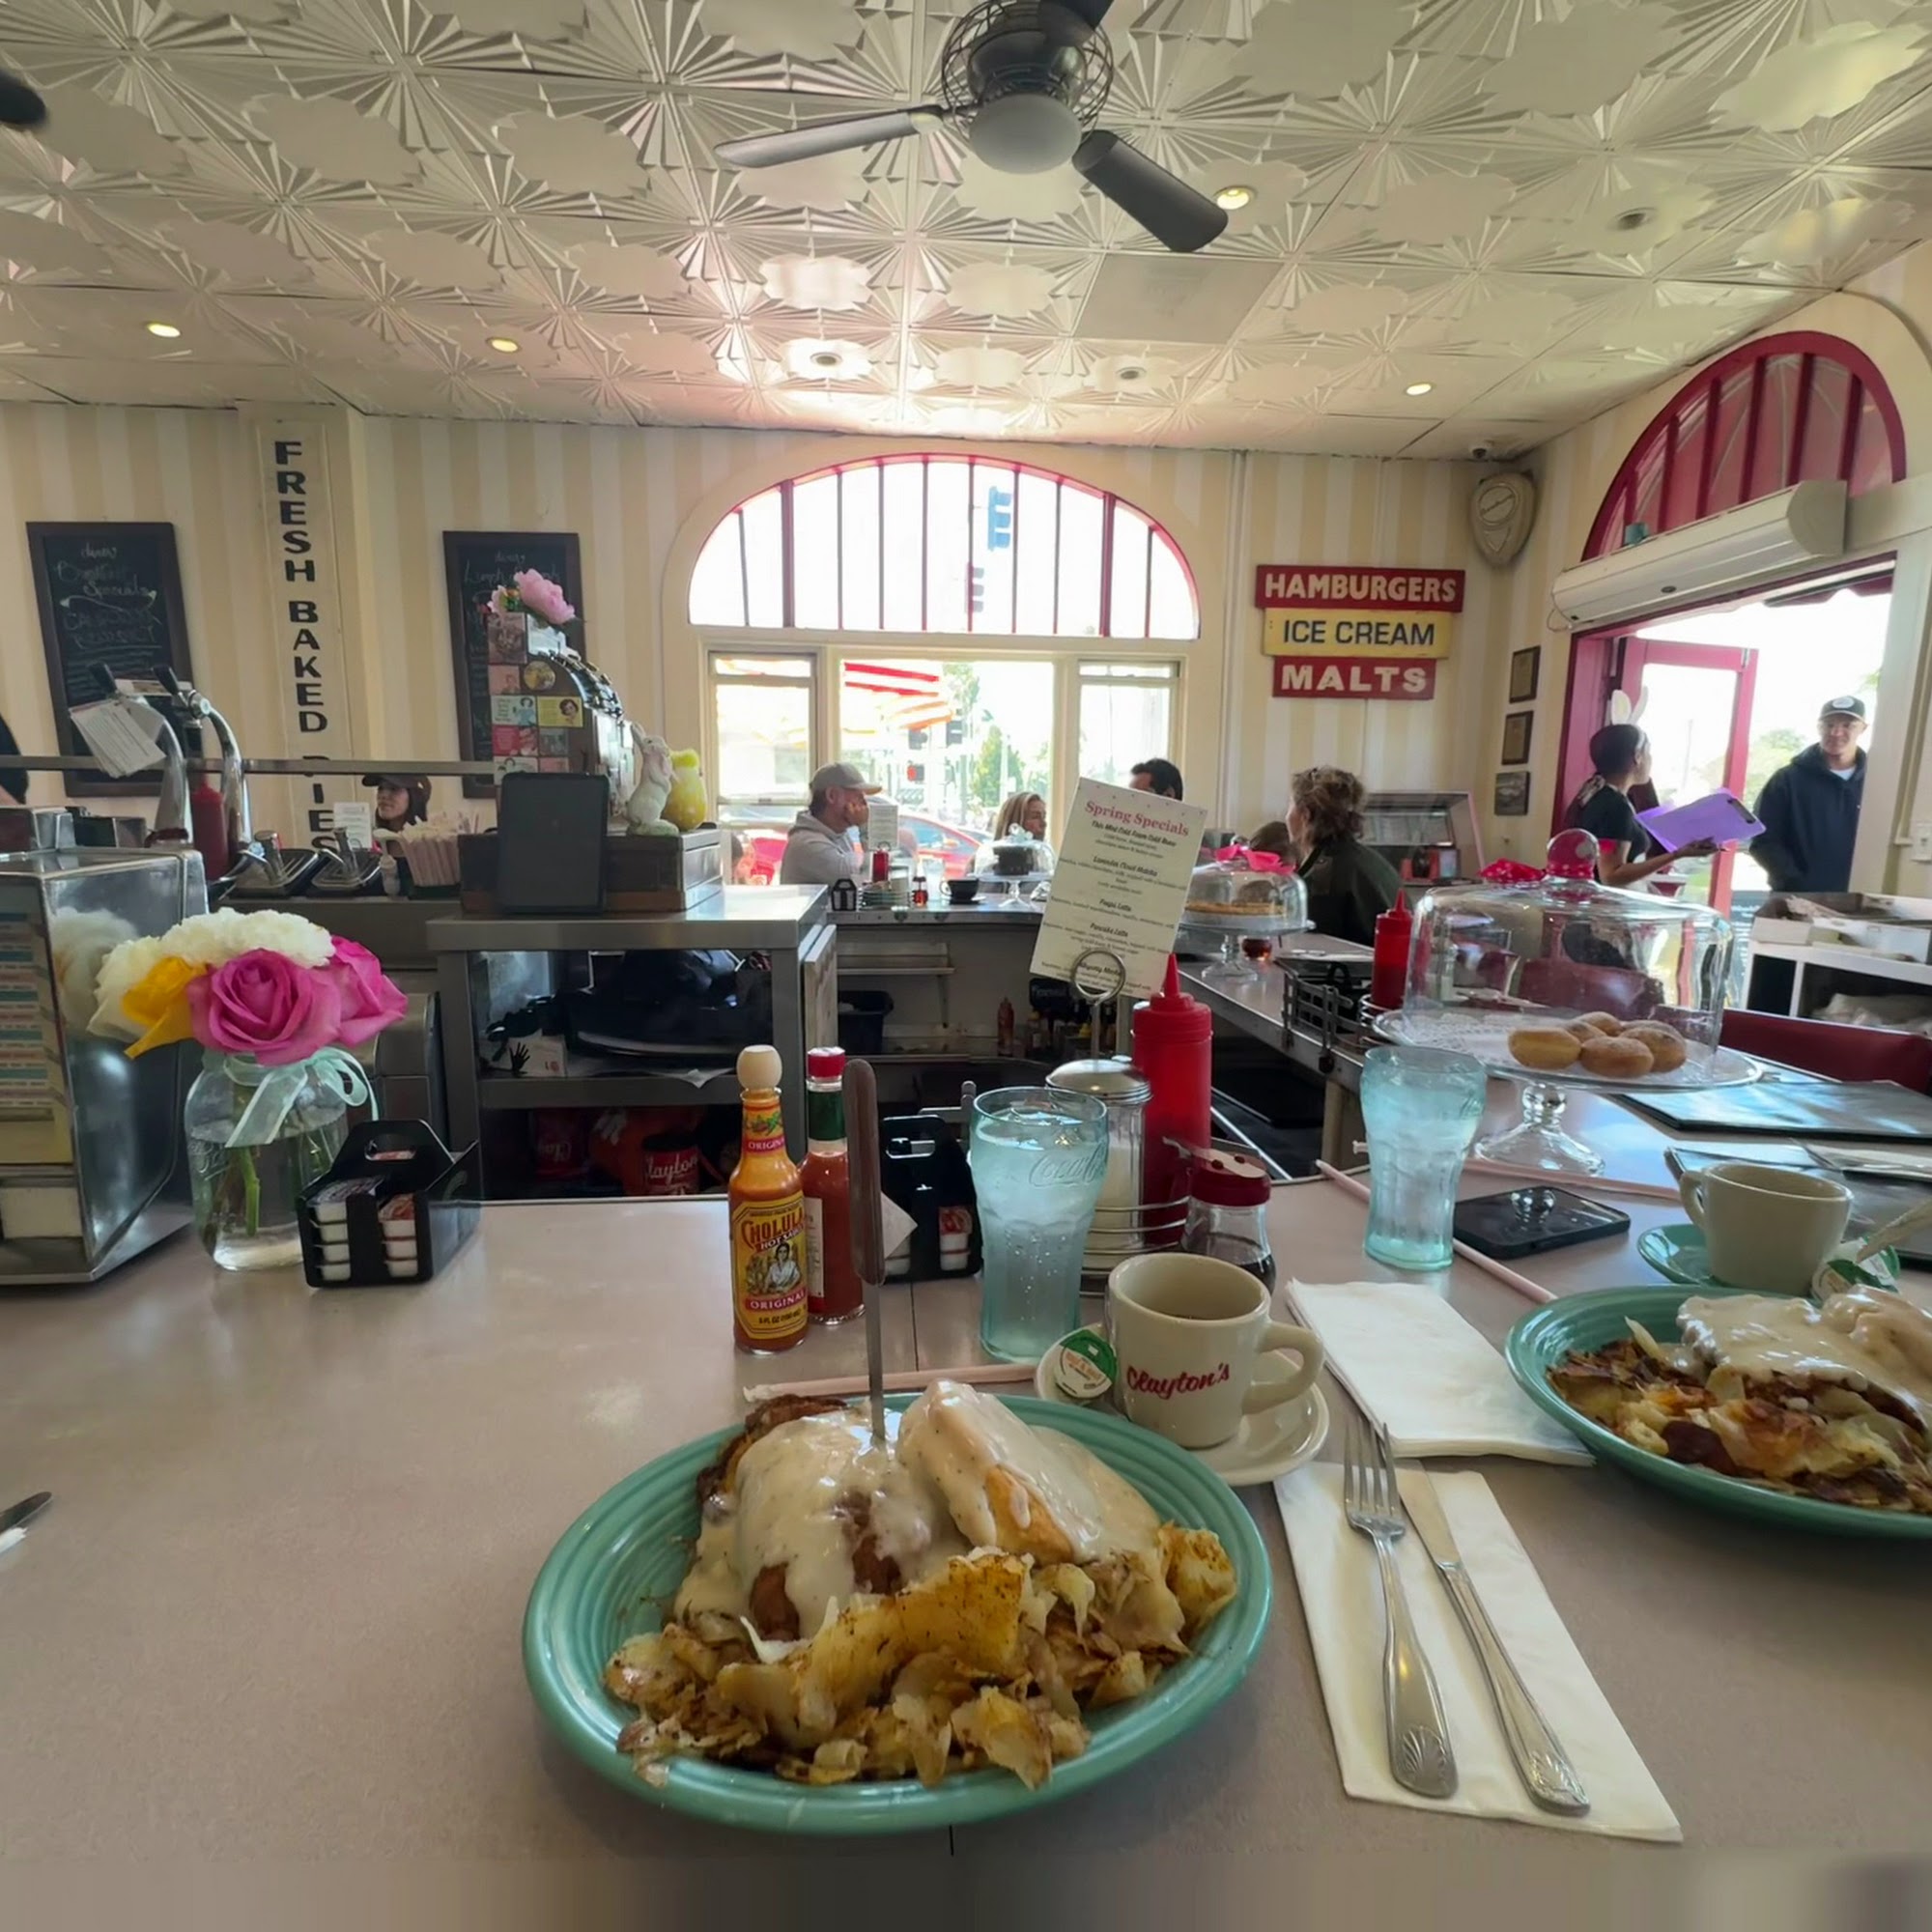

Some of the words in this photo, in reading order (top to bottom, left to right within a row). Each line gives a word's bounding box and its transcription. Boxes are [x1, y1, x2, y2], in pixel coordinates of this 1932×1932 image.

[275, 440, 315, 582] FRESH
[1264, 573, 1456, 602] HAMBURGERS
[1283, 620, 1326, 643] ICE
[1335, 621, 1435, 645] CREAM
[289, 601, 327, 732] BAKED
[1281, 665, 1427, 693] MALTS
[302, 755, 336, 855] IES
[1085, 800, 1133, 824] Spring
[1132, 811, 1190, 838] Specials
[749, 1138, 784, 1150] ORIGIN
[760, 1237, 781, 1250] HOT
[1126, 1363, 1230, 1400] Clayton's
